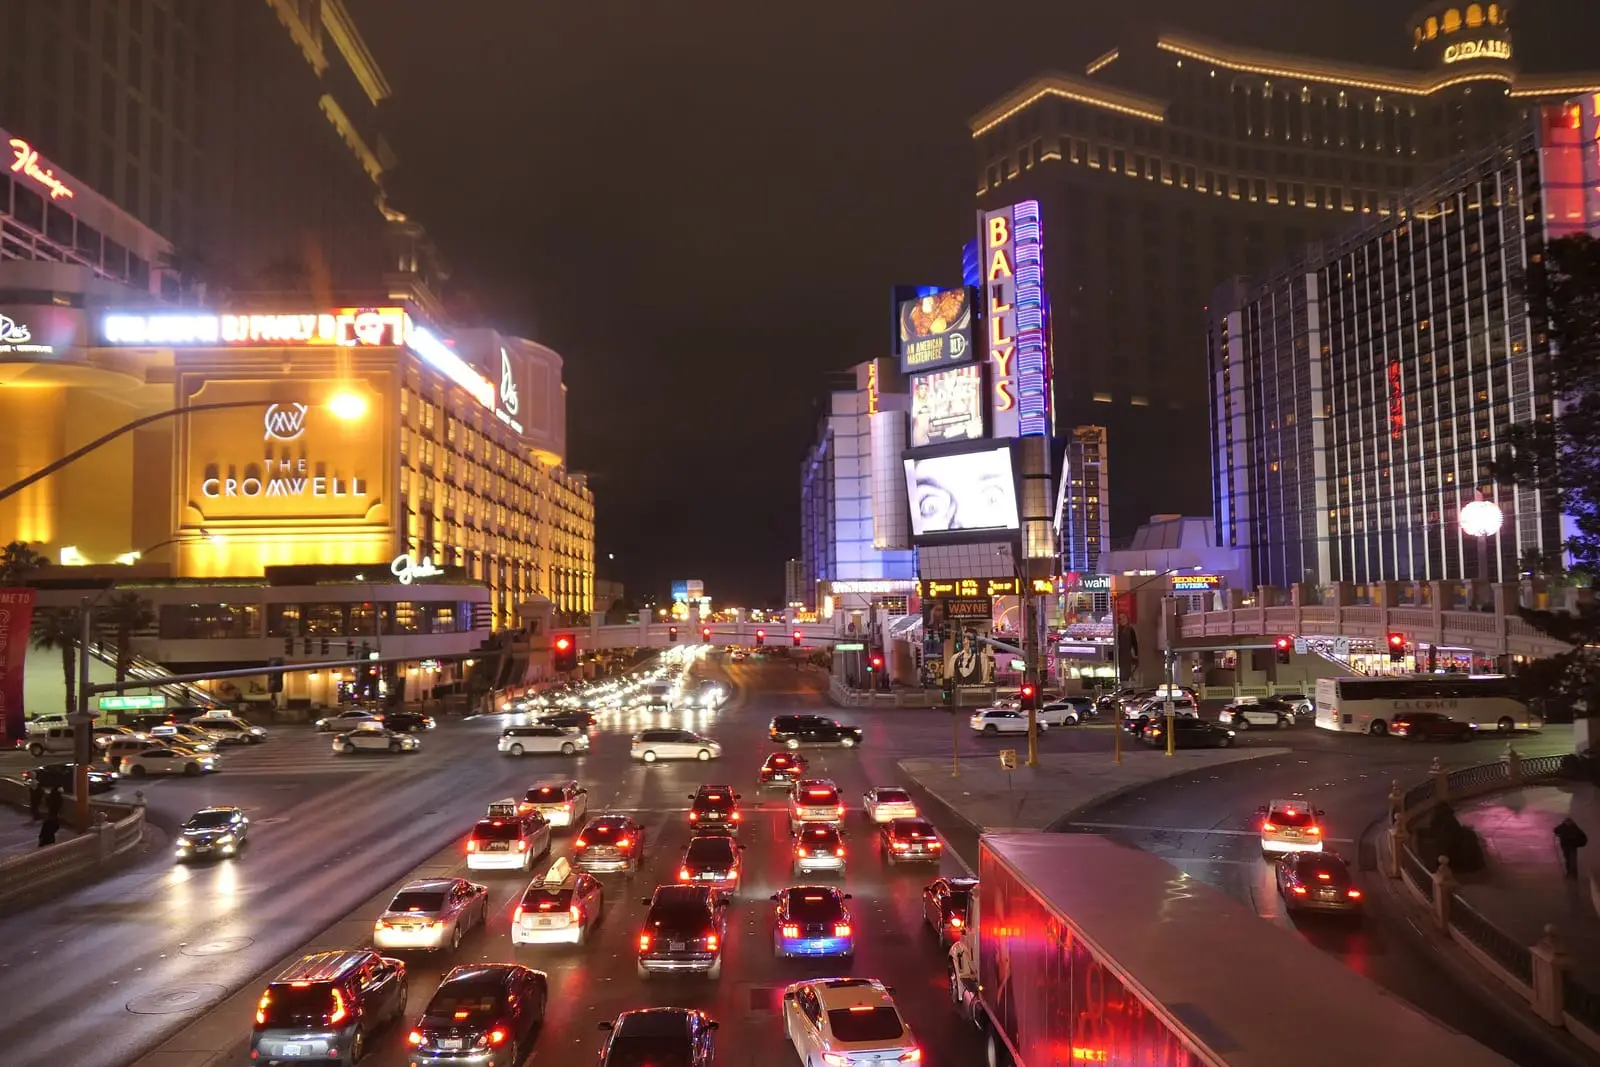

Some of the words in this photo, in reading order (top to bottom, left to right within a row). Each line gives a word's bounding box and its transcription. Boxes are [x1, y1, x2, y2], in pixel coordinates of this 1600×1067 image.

[264, 459, 307, 472] THE
[202, 476, 368, 498] CROMWELL
[948, 602, 988, 614] WAYNE
